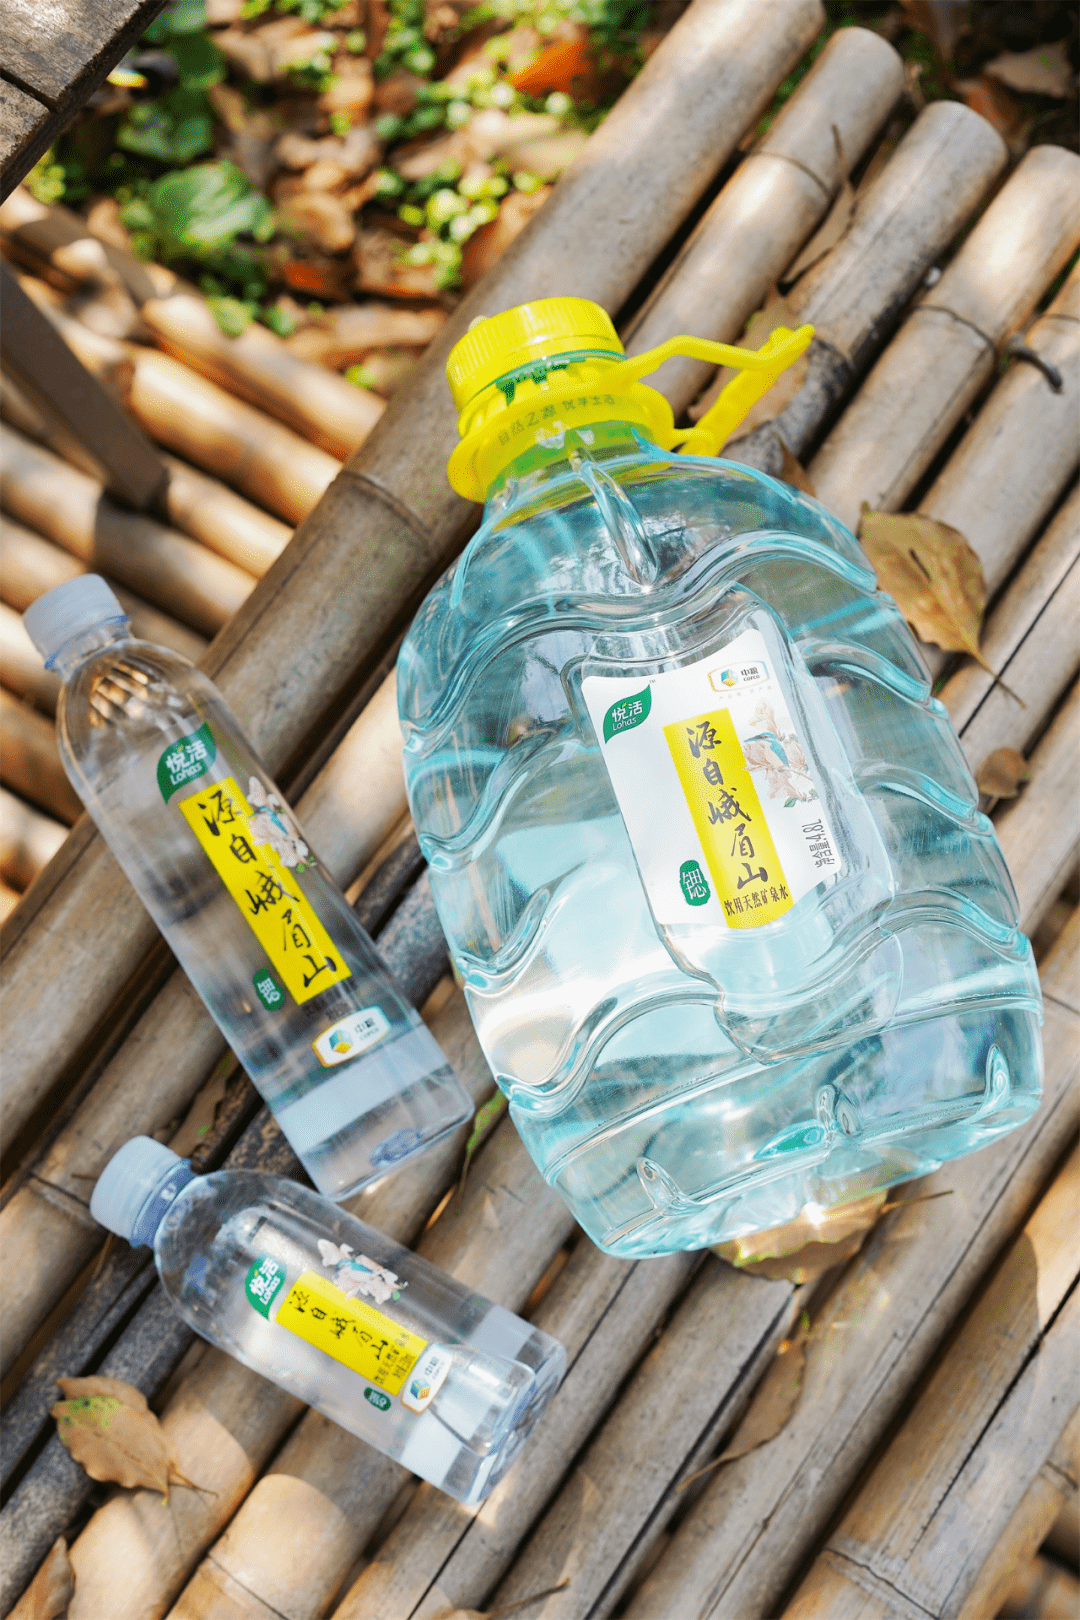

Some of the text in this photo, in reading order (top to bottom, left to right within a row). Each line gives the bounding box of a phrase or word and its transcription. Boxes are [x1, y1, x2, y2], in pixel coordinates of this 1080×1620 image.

[611, 699, 643, 723] 悦活
[612, 717, 637, 731] Lohas
[166, 739, 207, 774] 悦活
[170, 762, 203, 786] Lohas
[686, 721, 769, 890] 源自峨眉山
[198, 790, 337, 988] 源自峨眉山
[723, 884, 789, 917] 饮用天然矿泉水
[249, 1257, 279, 1296] 悦活
